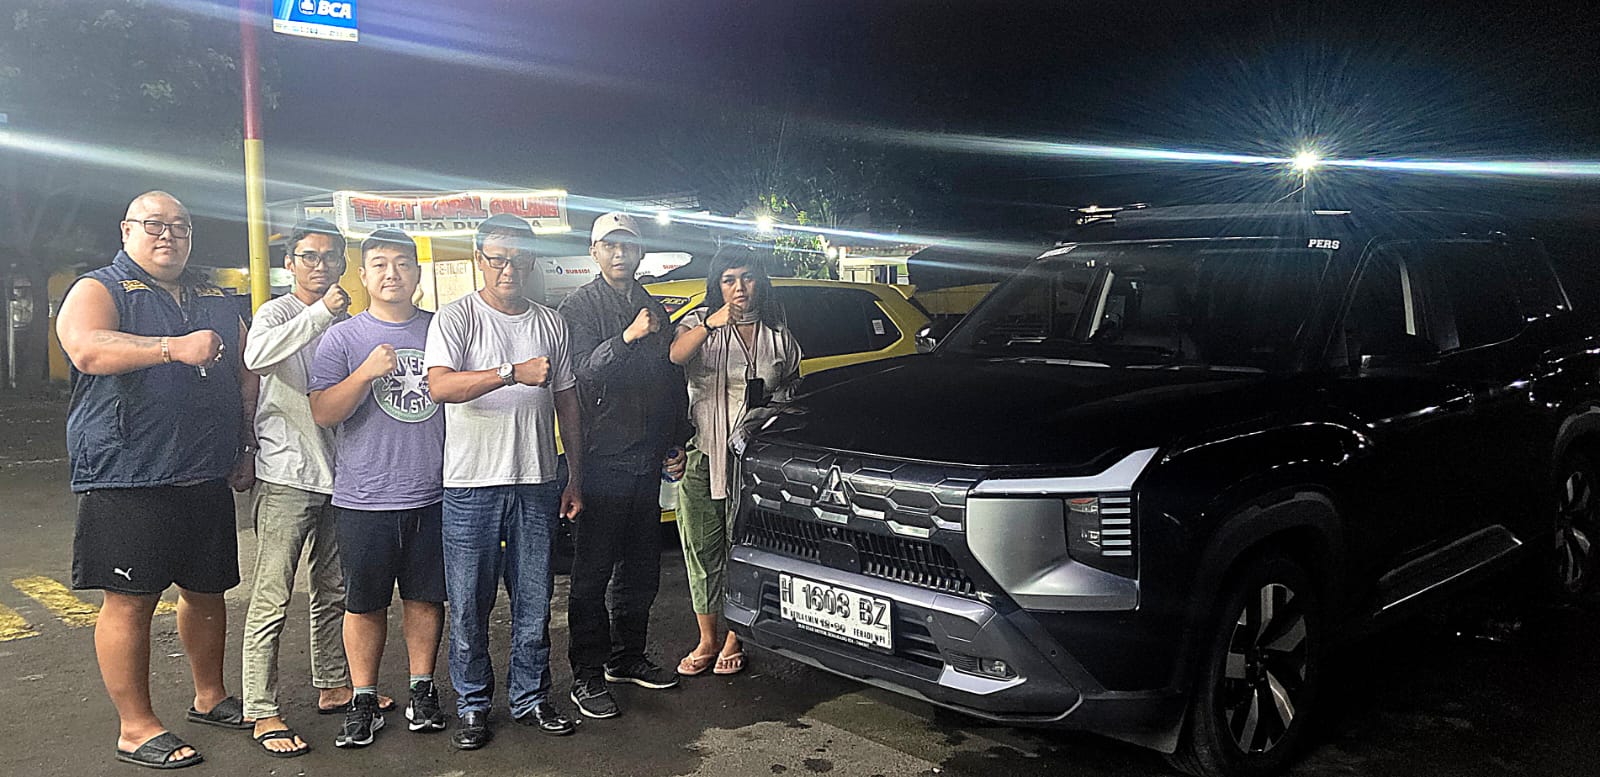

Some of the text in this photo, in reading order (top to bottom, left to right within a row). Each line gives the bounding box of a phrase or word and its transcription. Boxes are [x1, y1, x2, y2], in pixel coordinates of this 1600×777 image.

[317, 1, 352, 19] BCA
[421, 194, 488, 220] KAPAL
[1308, 239, 1341, 249] PERS
[384, 393, 432, 414] ALL STA
[782, 578, 794, 604] H
[859, 597, 888, 630] BZ
